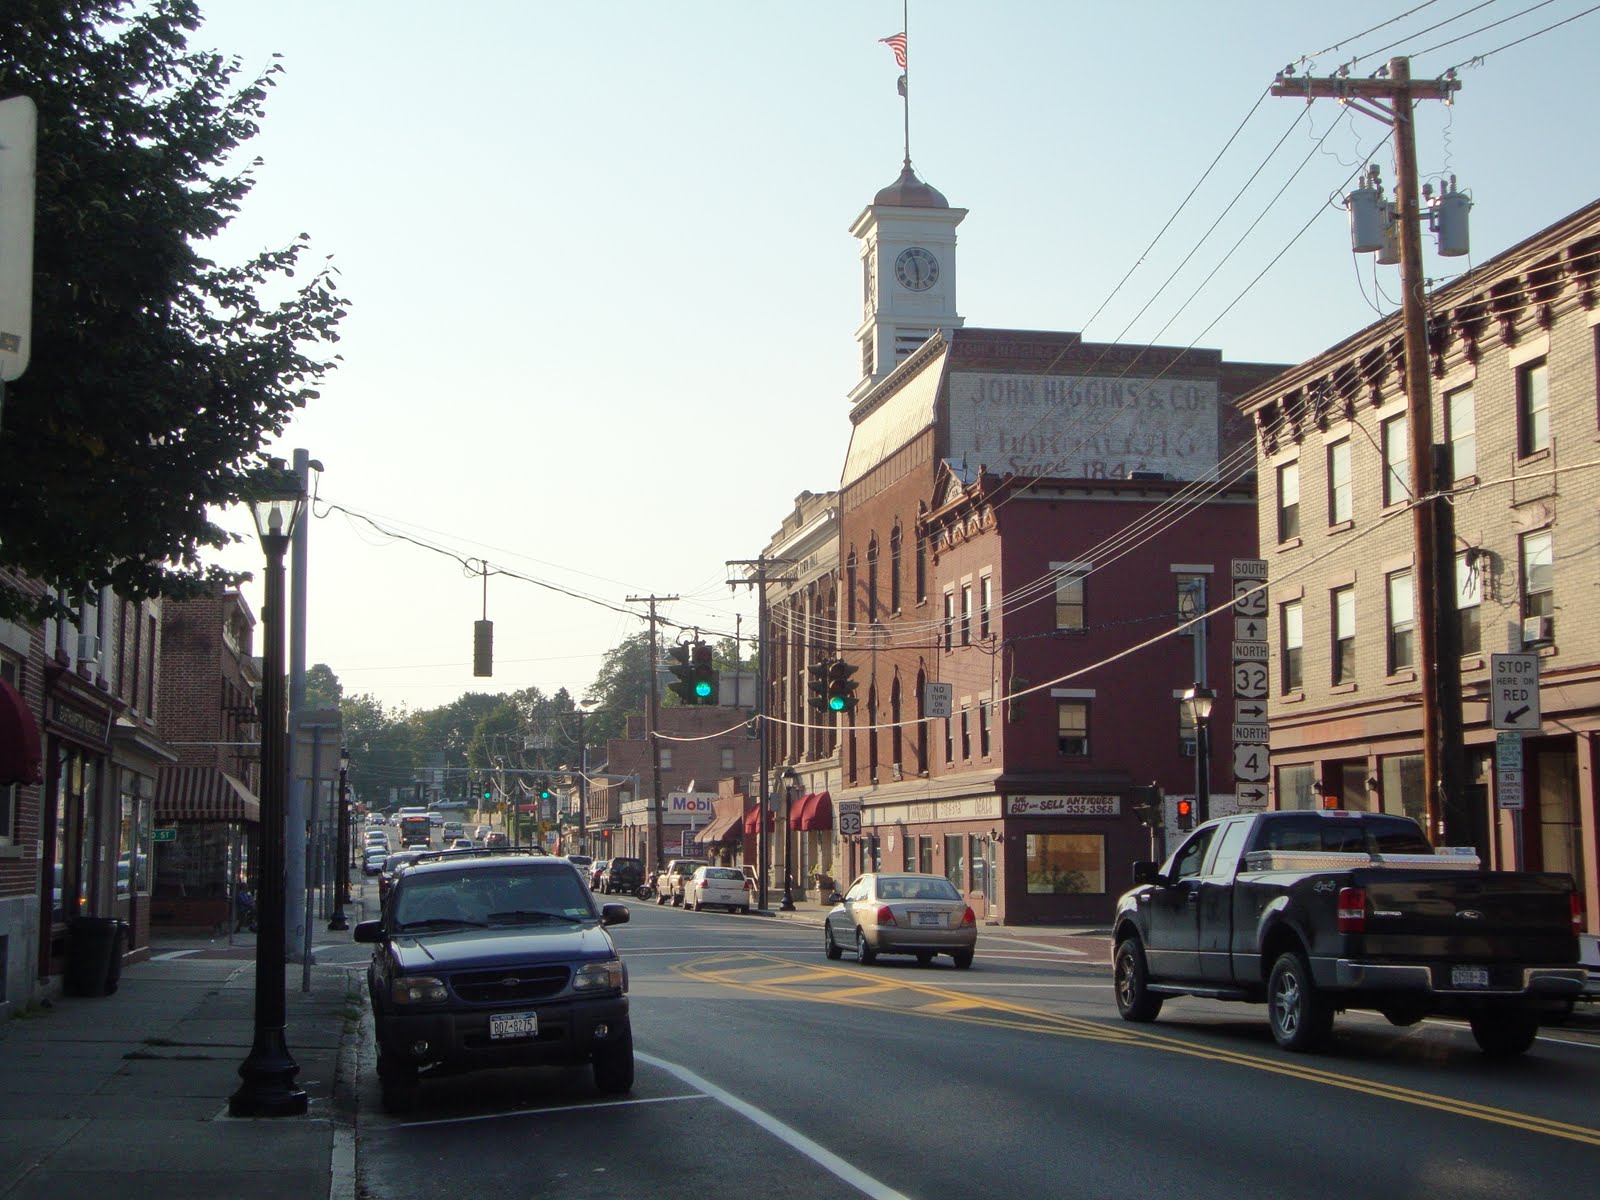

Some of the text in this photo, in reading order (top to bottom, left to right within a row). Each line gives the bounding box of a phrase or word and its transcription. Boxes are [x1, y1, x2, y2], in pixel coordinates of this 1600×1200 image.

[971, 377, 1036, 405] JOHN
[1044, 379, 1140, 409] HIGGINS
[1235, 562, 1266, 575] SOUTH
[1236, 586, 1266, 609] 32
[1235, 645, 1267, 657] NORTH
[1498, 661, 1532, 674] STOP
[1236, 669, 1267, 691] 32
[1496, 677, 1534, 685] HERE ON
[933, 685, 945, 693] NO
[1503, 689, 1529, 701] RED
[1235, 727, 1267, 739] NORTH
[1244, 753, 1260, 774] 4
[1504, 773, 1515, 781] NO
[673, 797, 713, 811] Mobi
[1040, 799, 1065, 811] SELL
[1066, 796, 1114, 805] ANTIQUES
[841, 803, 859, 811] SOUTH
[842, 818, 859, 830] 32
[160, 831, 170, 839] ST
